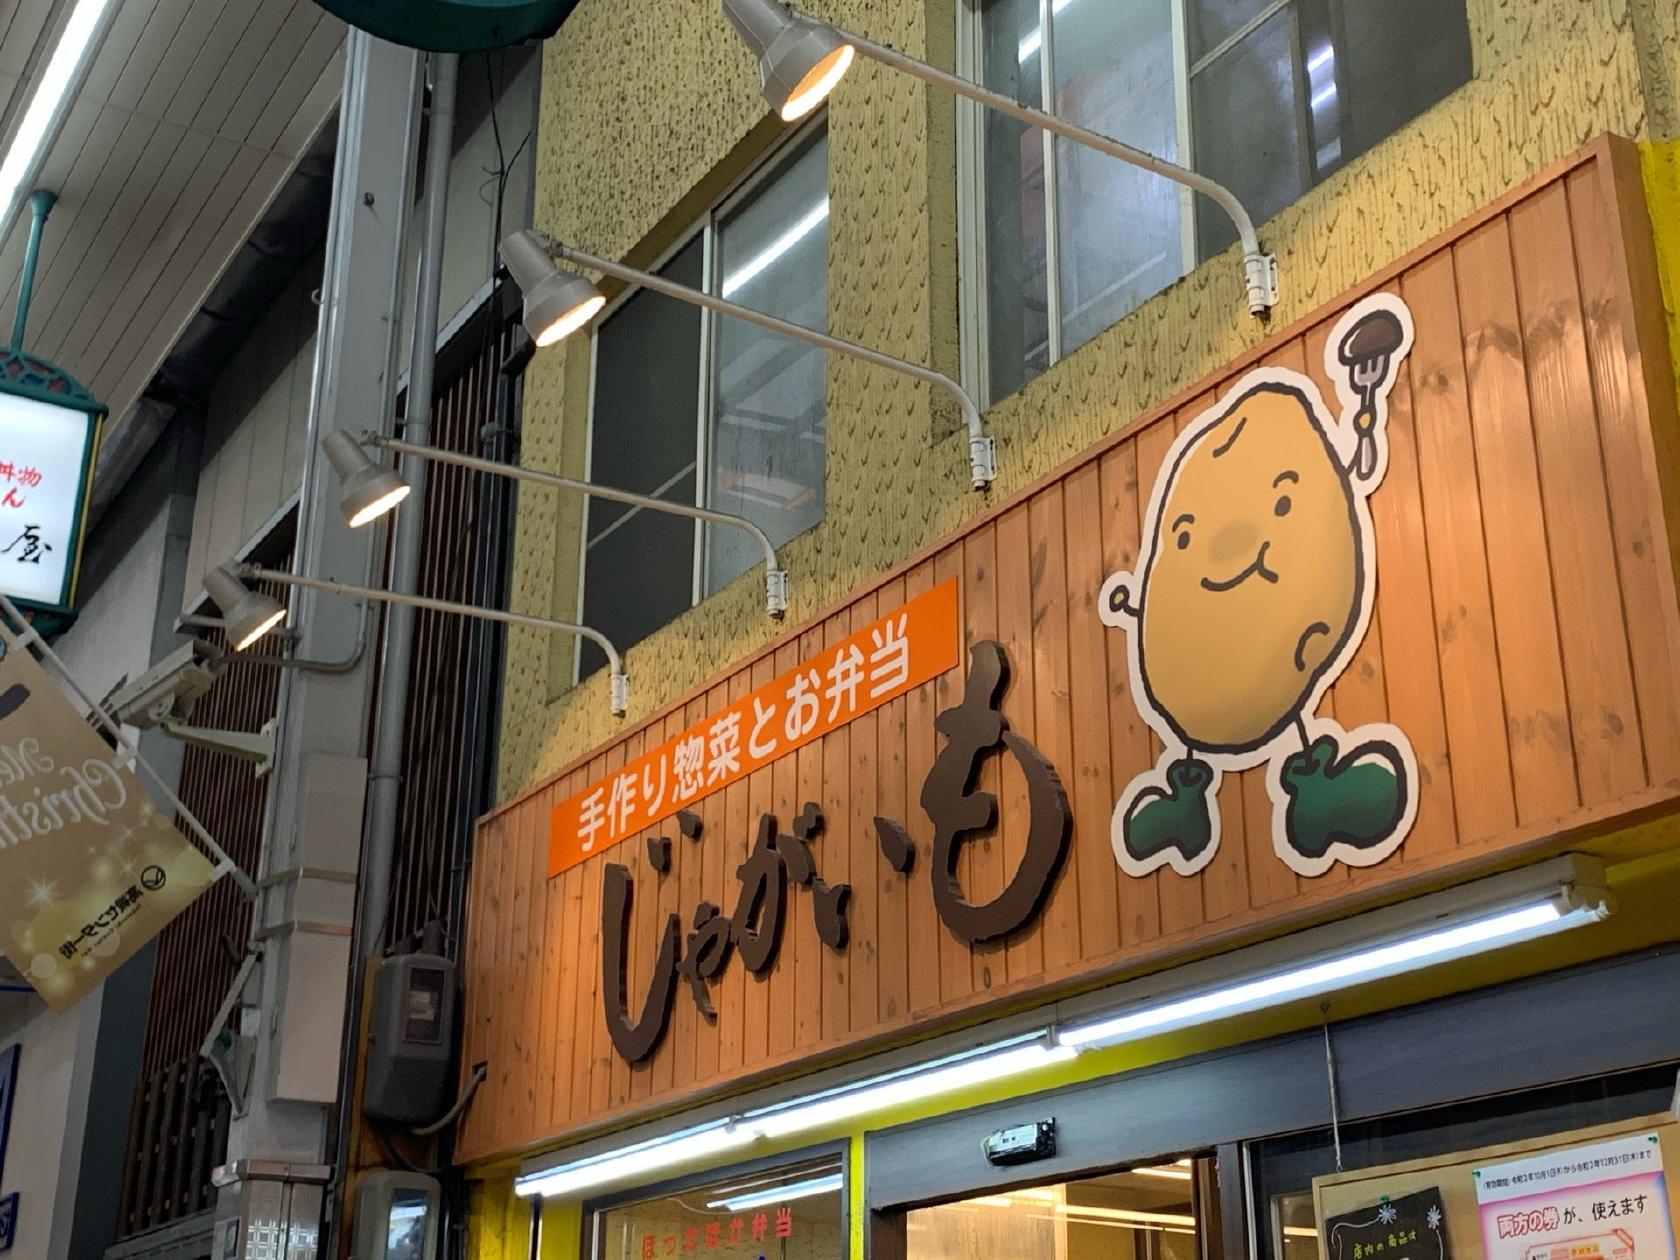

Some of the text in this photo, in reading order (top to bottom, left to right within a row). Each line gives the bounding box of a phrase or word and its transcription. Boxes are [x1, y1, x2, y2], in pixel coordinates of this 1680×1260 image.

[577, 612, 909, 852] 手作り惣菜とお弁当
[602, 640, 1073, 1066] じゃがいも
